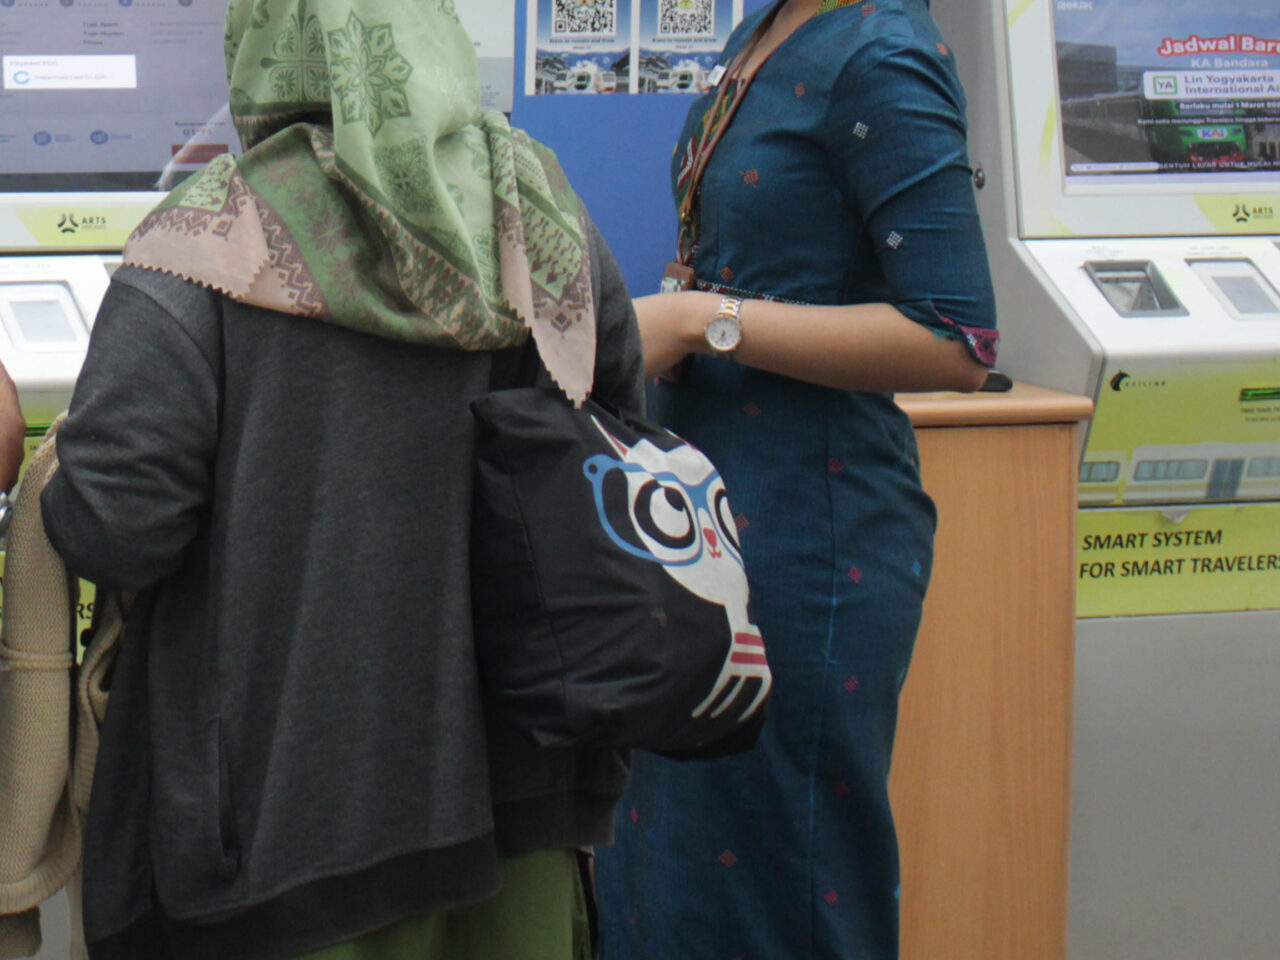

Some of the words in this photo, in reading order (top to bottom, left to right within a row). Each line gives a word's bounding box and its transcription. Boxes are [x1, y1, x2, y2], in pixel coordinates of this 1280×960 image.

[1160, 35, 1236, 55] Jadwal
[1191, 59, 1212, 68] KA
[1214, 58, 1269, 68] Bandara
[1184, 74, 1203, 84] Lin
[1206, 74, 1274, 85] Yogyakarta
[1157, 81, 1173, 89] YA
[1185, 85, 1263, 95] International
[81, 217, 107, 225] ARTS
[1082, 532, 1148, 551] SMART
[1152, 529, 1223, 549] SYSTEM
[1079, 561, 1115, 579] FOR
[1120, 559, 1186, 577] SMART
